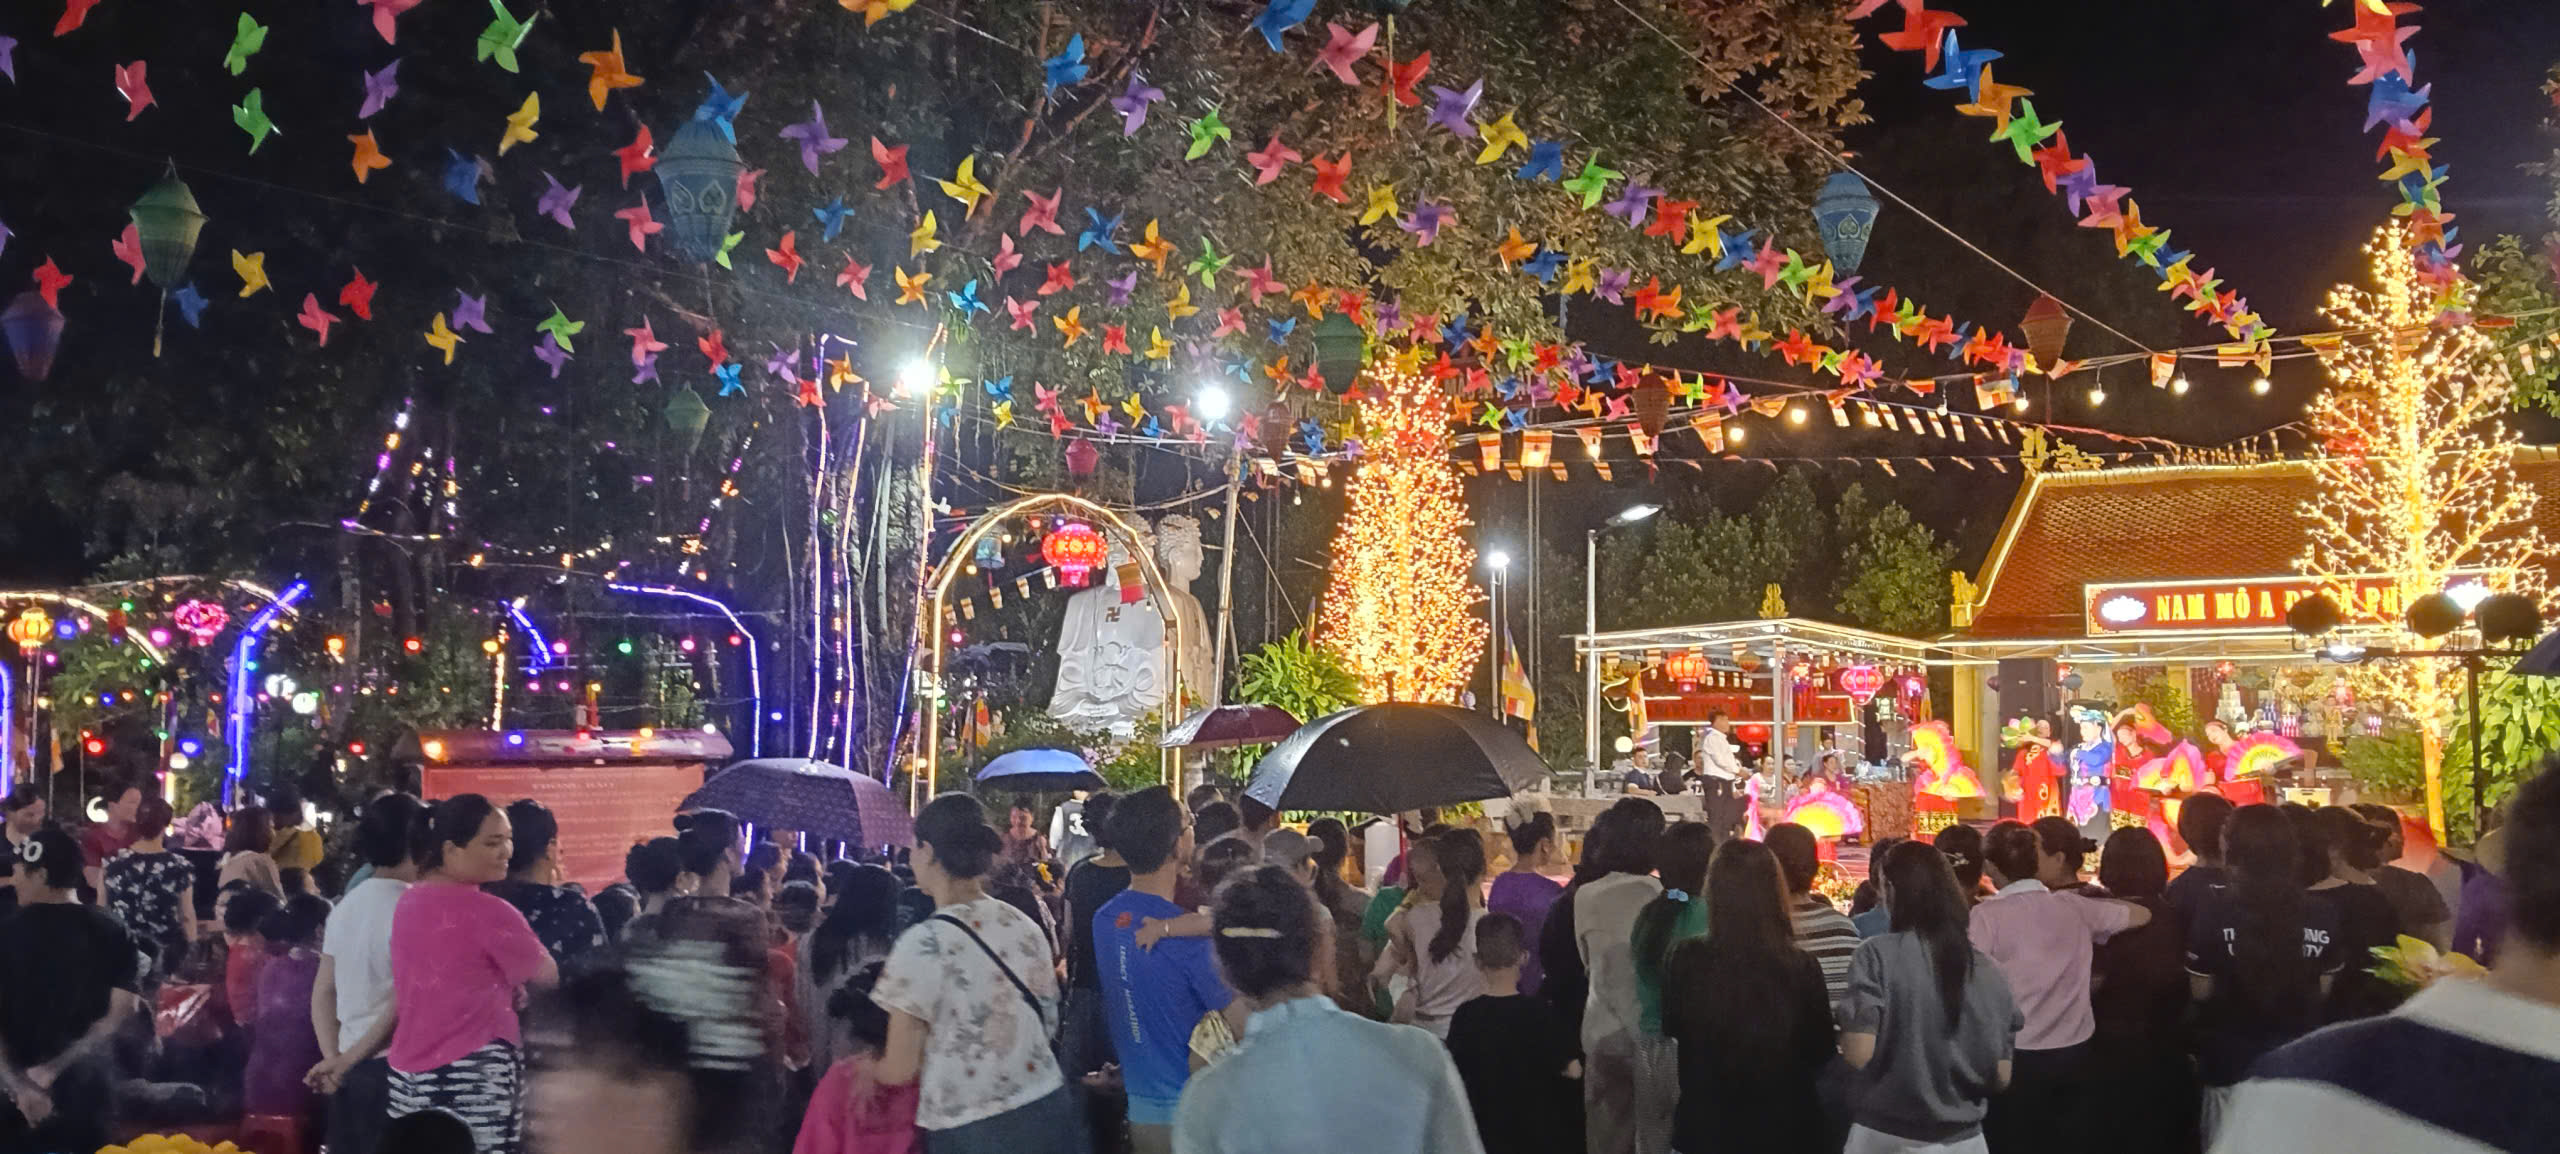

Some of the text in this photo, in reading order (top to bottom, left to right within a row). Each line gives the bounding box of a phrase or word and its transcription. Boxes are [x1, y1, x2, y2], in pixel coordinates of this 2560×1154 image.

[2156, 593, 2206, 621] NAM
[2215, 586, 2251, 619] MÔ
[2259, 591, 2275, 618] A
